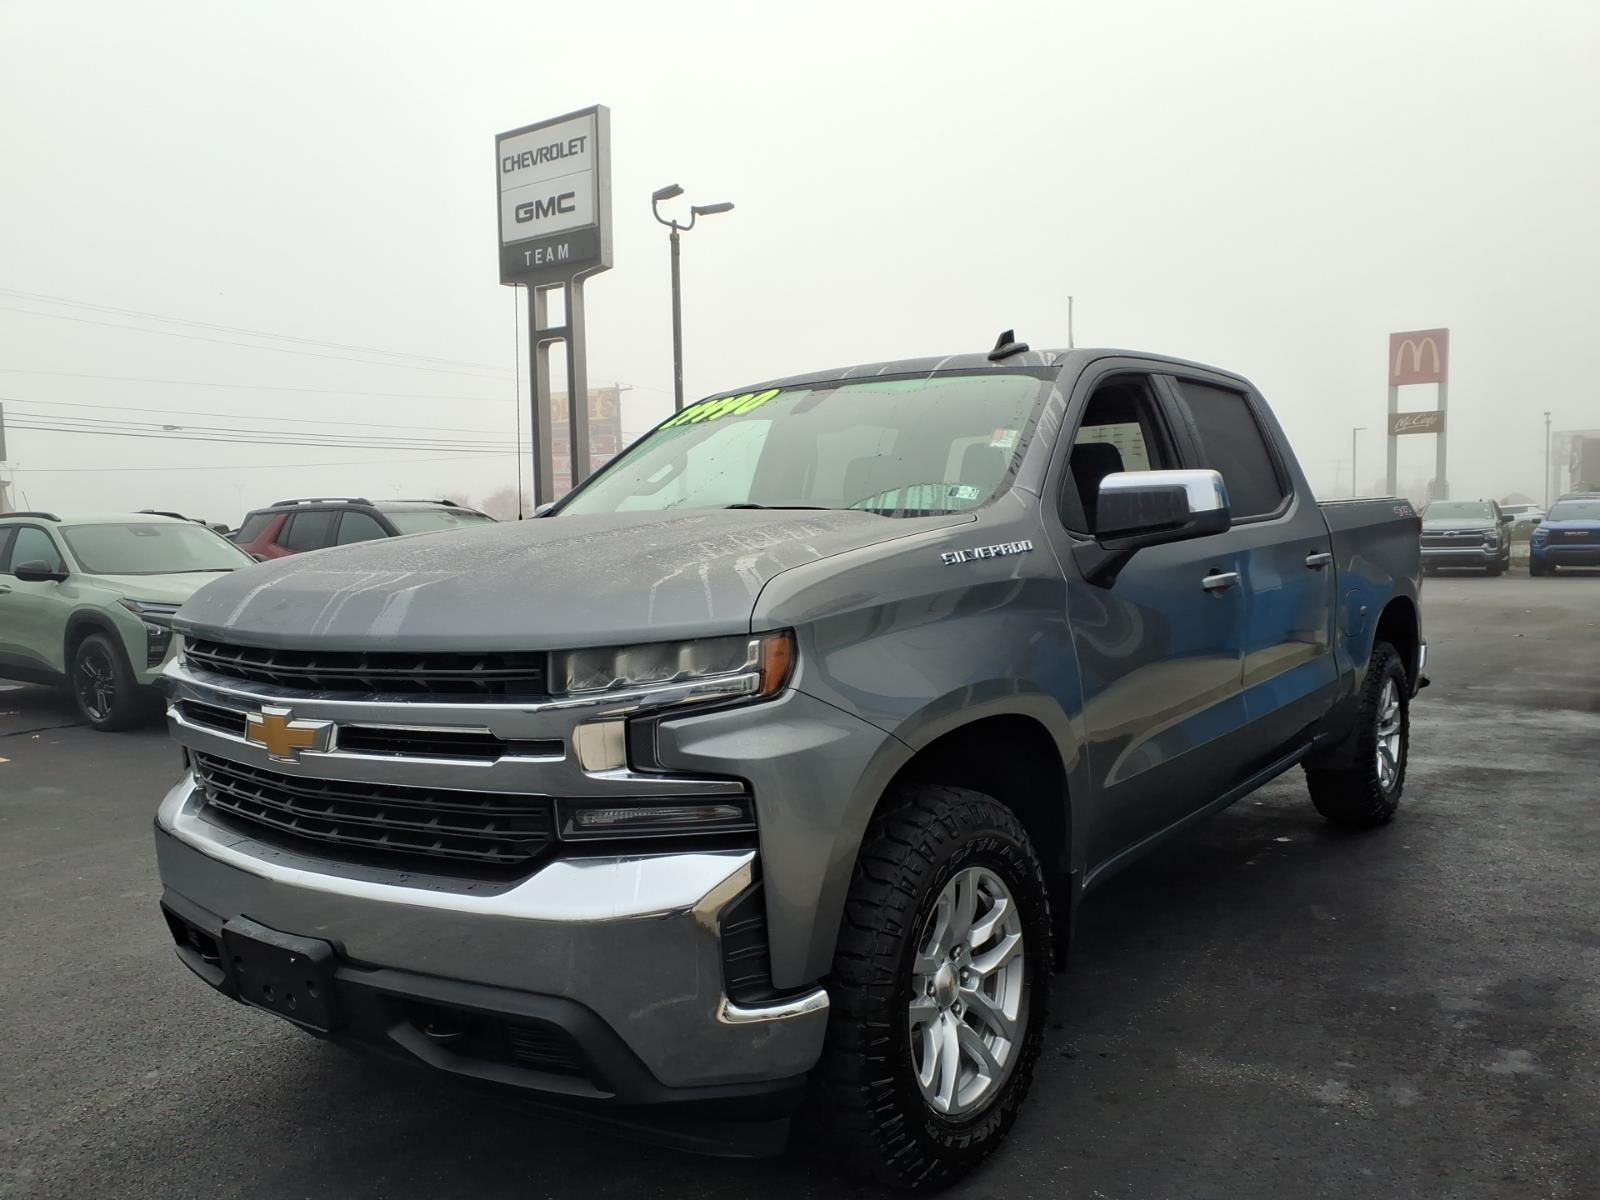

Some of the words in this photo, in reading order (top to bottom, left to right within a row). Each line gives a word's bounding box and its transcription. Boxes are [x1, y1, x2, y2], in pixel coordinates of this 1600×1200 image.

[502, 135, 587, 174] CHEVROLET
[515, 191, 576, 224] GMC
[524, 243, 569, 266] TEAM
[940, 539, 1034, 565] SILVERADO
